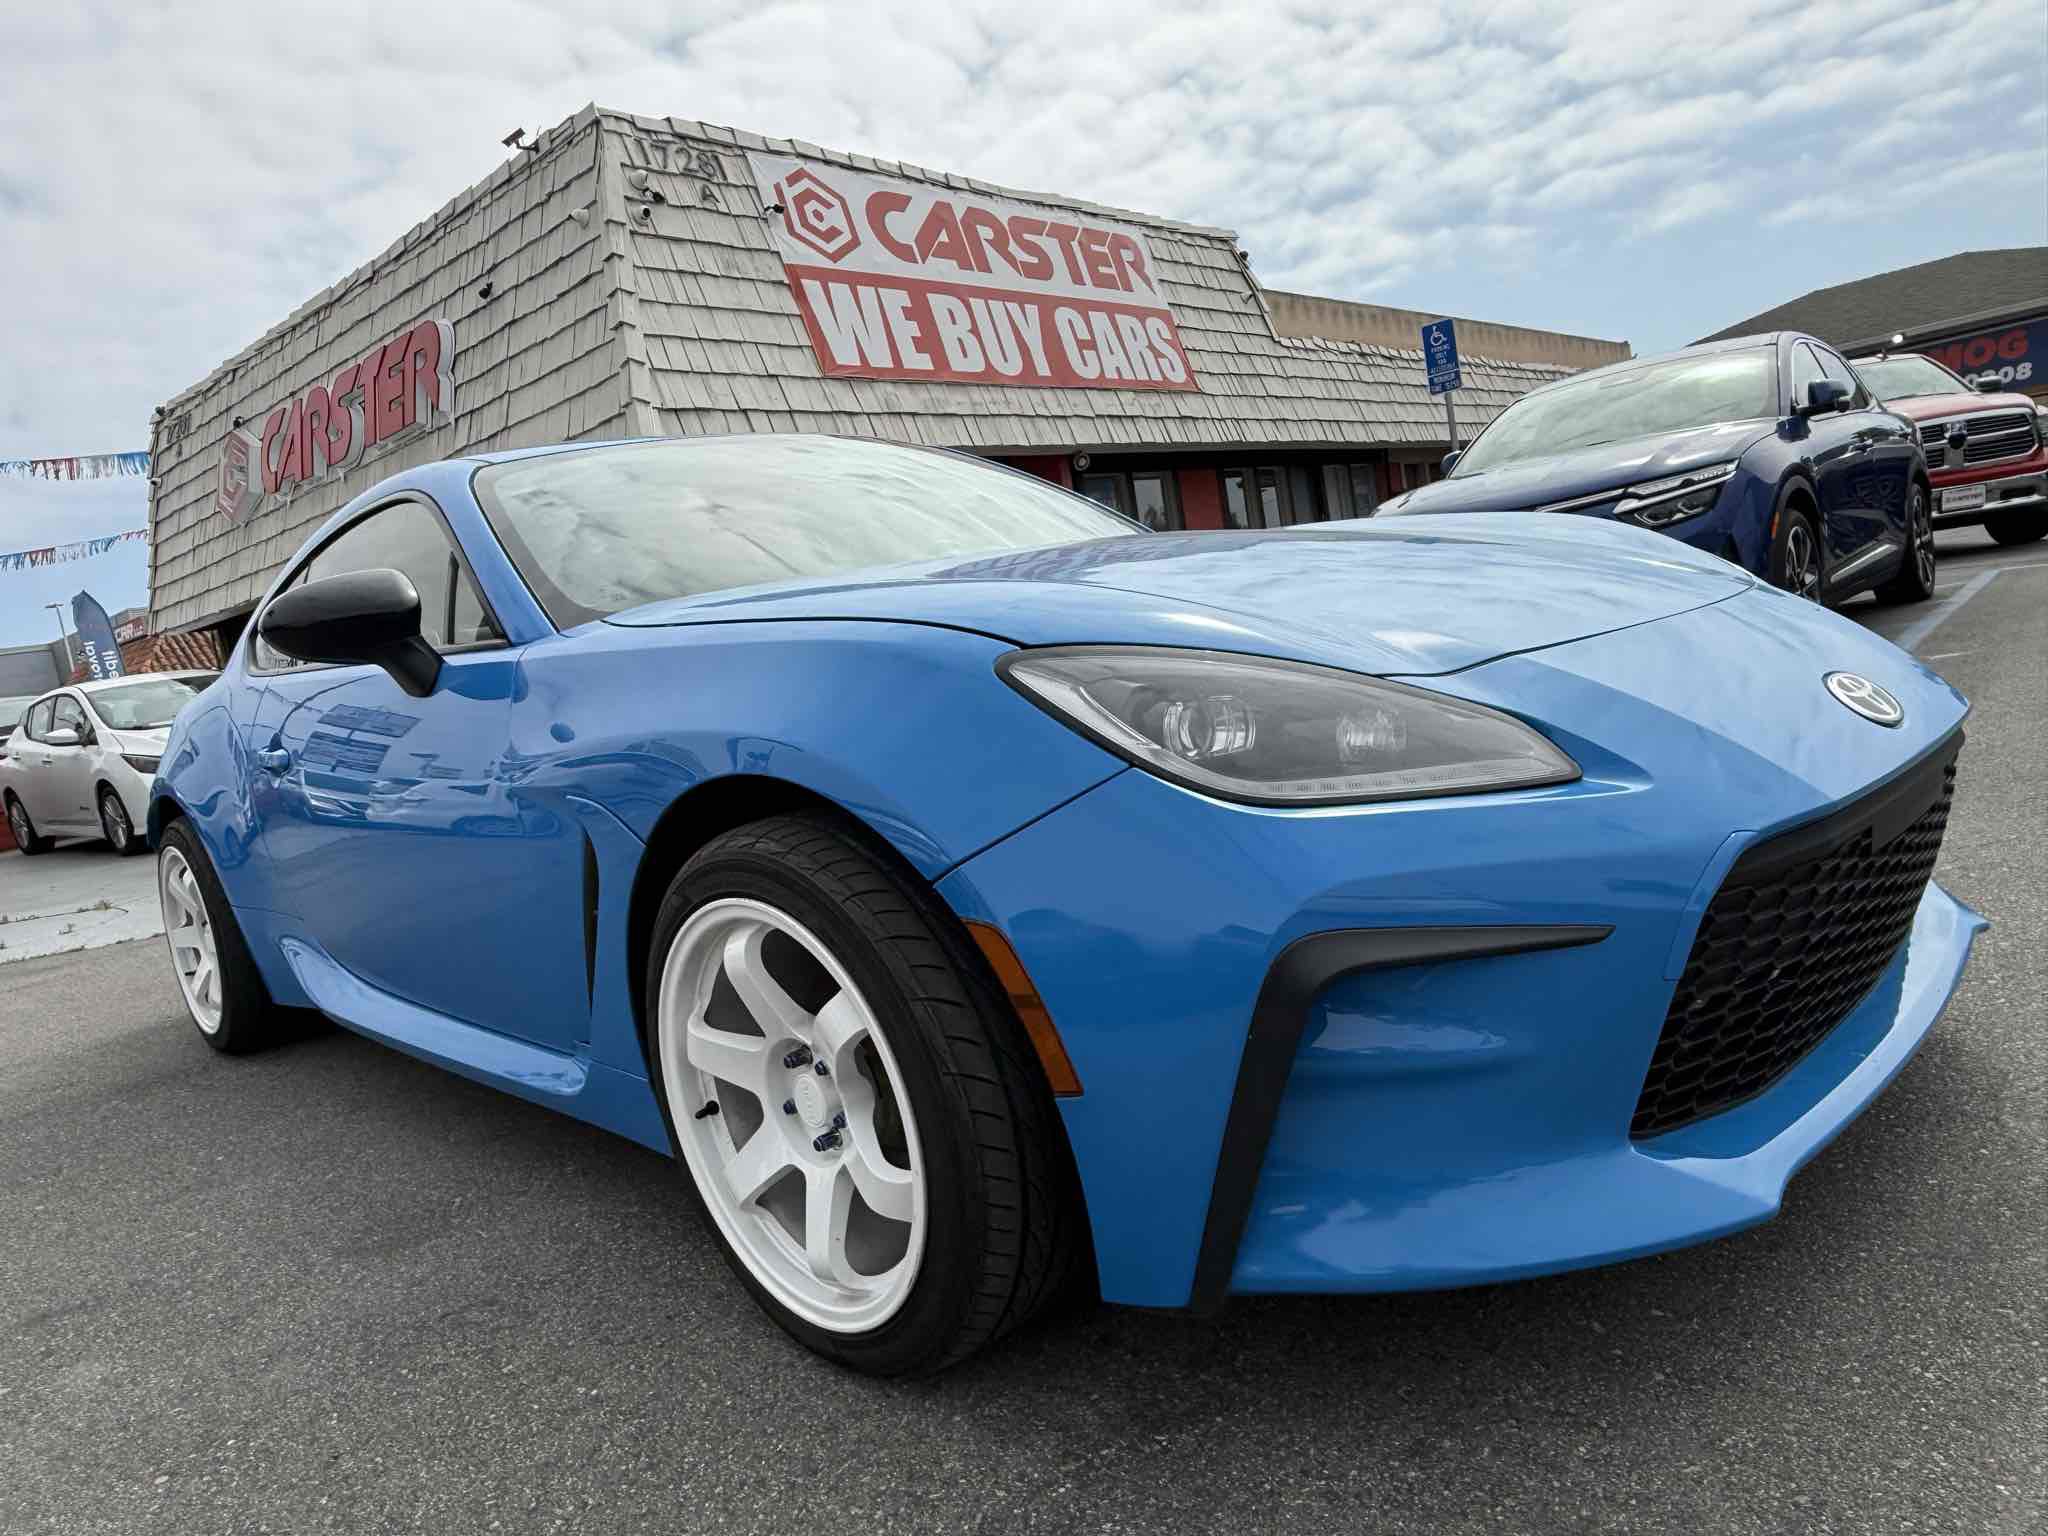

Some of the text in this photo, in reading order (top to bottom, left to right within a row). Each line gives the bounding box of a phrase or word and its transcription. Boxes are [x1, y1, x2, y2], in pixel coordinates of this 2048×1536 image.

[702, 184, 720, 203] A
[864, 190, 1156, 295] CARSTER
[800, 278, 1187, 384] WE BUY CARS
[1922, 329, 2029, 369] MOG
[261, 319, 445, 496] CARSTER
